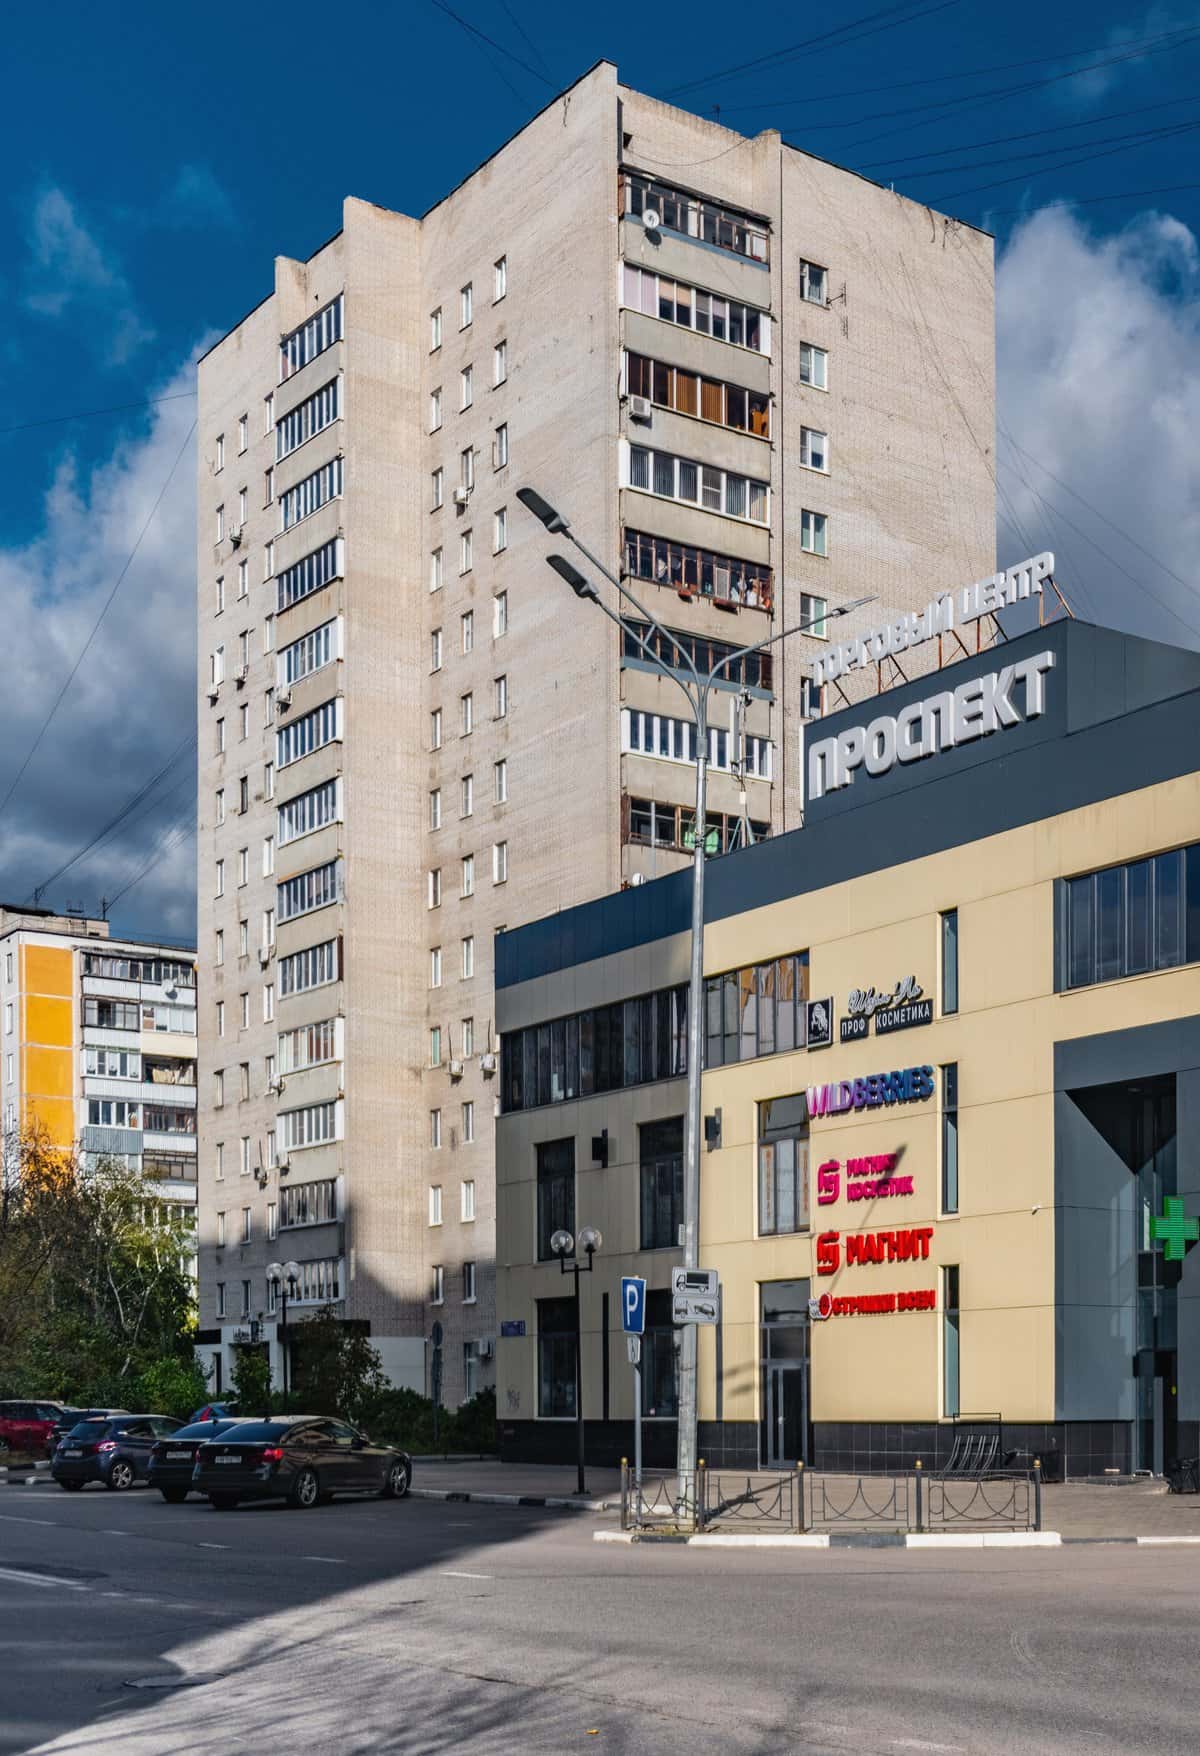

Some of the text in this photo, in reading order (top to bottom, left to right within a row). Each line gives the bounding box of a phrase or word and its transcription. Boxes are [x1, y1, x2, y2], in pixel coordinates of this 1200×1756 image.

[807, 551, 1055, 688] ТОРГОВЫЙ ЦЕНТР
[808, 650, 1057, 800] ПРОСПЕКТ
[841, 1002, 930, 1037] ПРОФ КОСМЕТИКА
[805, 1065, 935, 1117] WILDBERRIES
[846, 1228, 934, 1267] МАГНИТ
